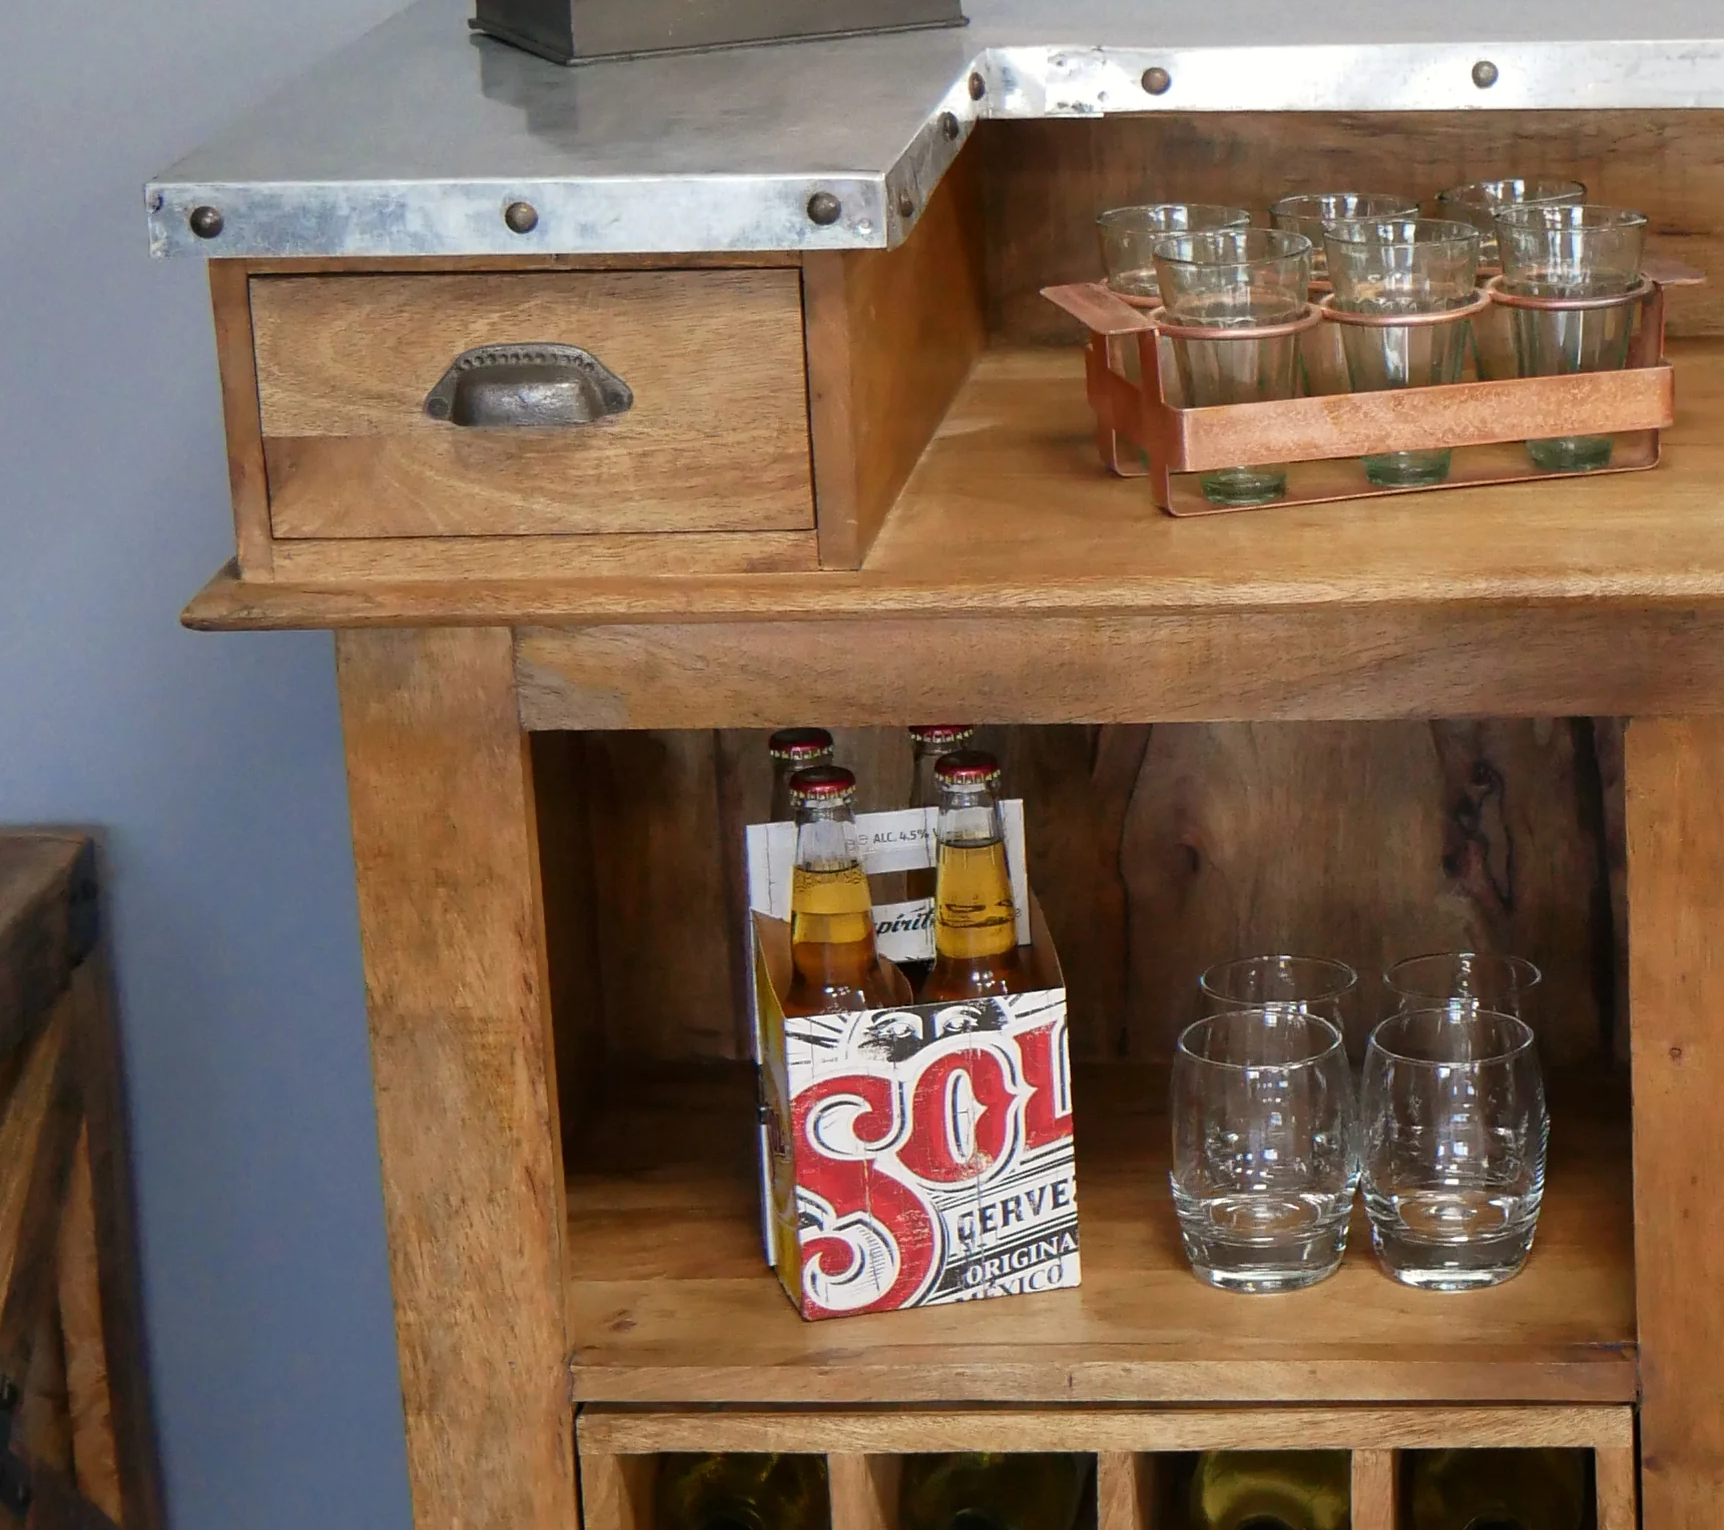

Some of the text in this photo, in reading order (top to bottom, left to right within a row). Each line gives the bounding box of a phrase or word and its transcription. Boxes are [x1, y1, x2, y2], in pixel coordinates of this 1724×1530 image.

[873, 833, 896, 844] ALC.
[899, 829, 929, 841] 4.5%
[792, 1019, 1074, 1321] SOL
[958, 1176, 1076, 1240] CERVE
